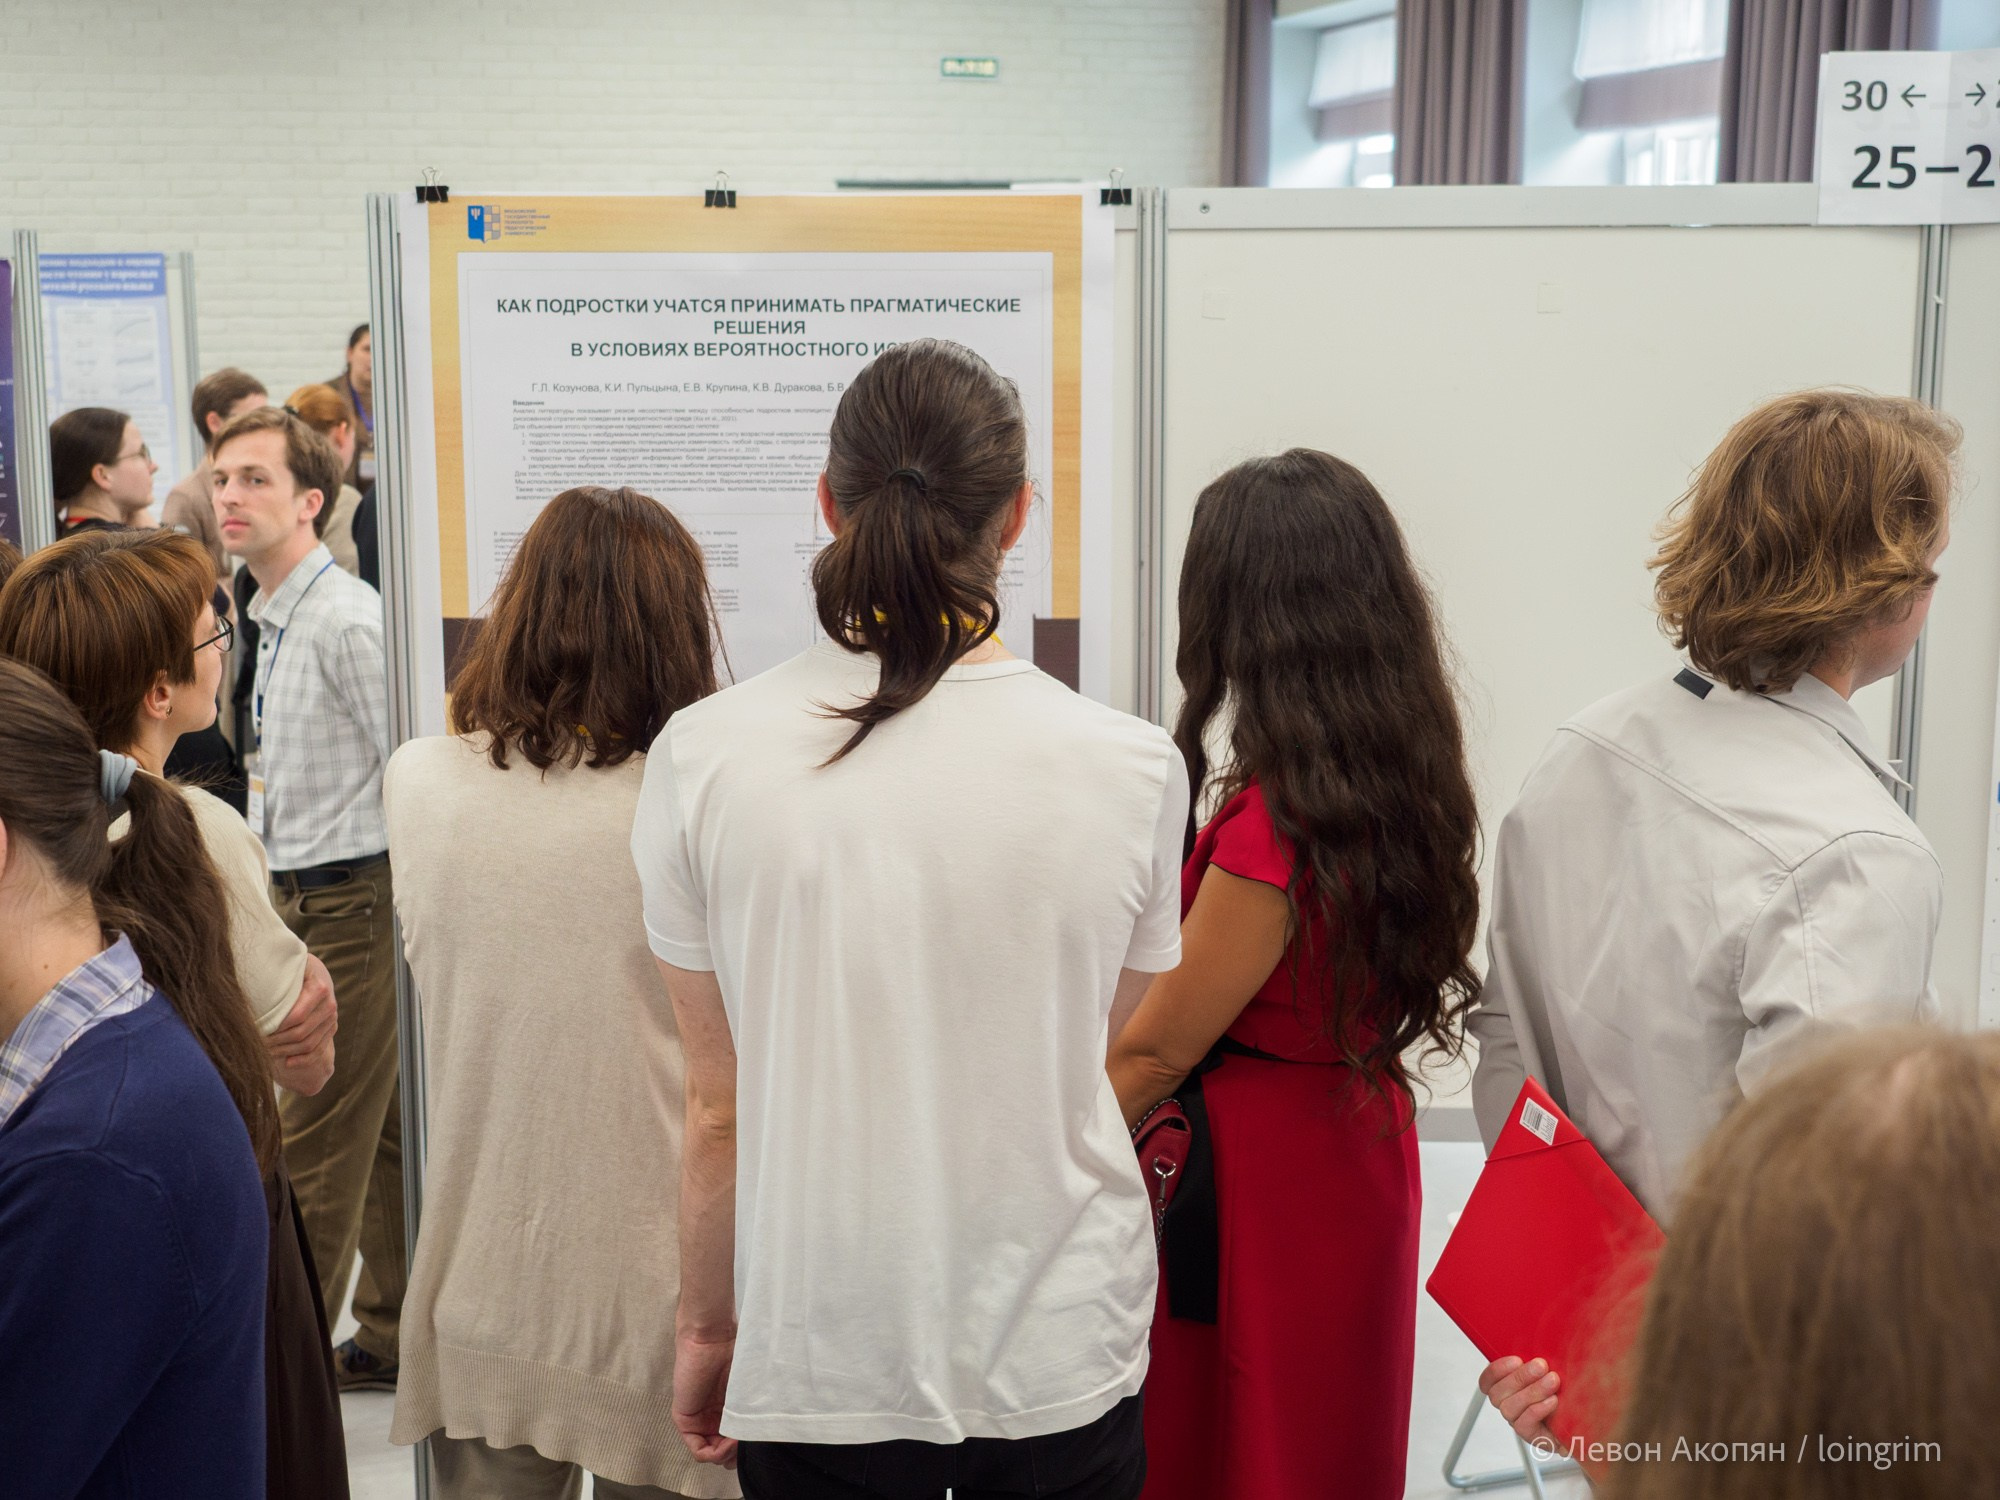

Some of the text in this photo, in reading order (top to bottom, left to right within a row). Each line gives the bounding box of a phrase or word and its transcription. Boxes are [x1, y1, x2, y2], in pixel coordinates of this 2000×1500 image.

[1842, 81, 1887, 111] 30
[1852, 144, 2000, 190] 25–2
[498, 299, 1020, 315] КАК ПОДРОСТКИ УЧАТСЯ ПРИНИМАТЬ ПРАГМАТИЧЕСКИЕ
[715, 321, 805, 334] РЕШЕНИЯ
[572, 343, 582, 356] В
[588, 343, 688, 356] УСЛОВИЯХ
[695, 343, 868, 356] ВЕРОЯТНОСТНОГО
[532, 383, 549, 393] Г.Л.
[552, 383, 602, 394] Козунова,
[604, 383, 625, 393] К.И.
[627, 383, 681, 395] Пульцына,
[683, 383, 704, 393] Е.В.
[706, 383, 750, 395] Крупина,
[753, 383, 773, 393] К.В.
[774, 383, 826, 395] Дуракова,
